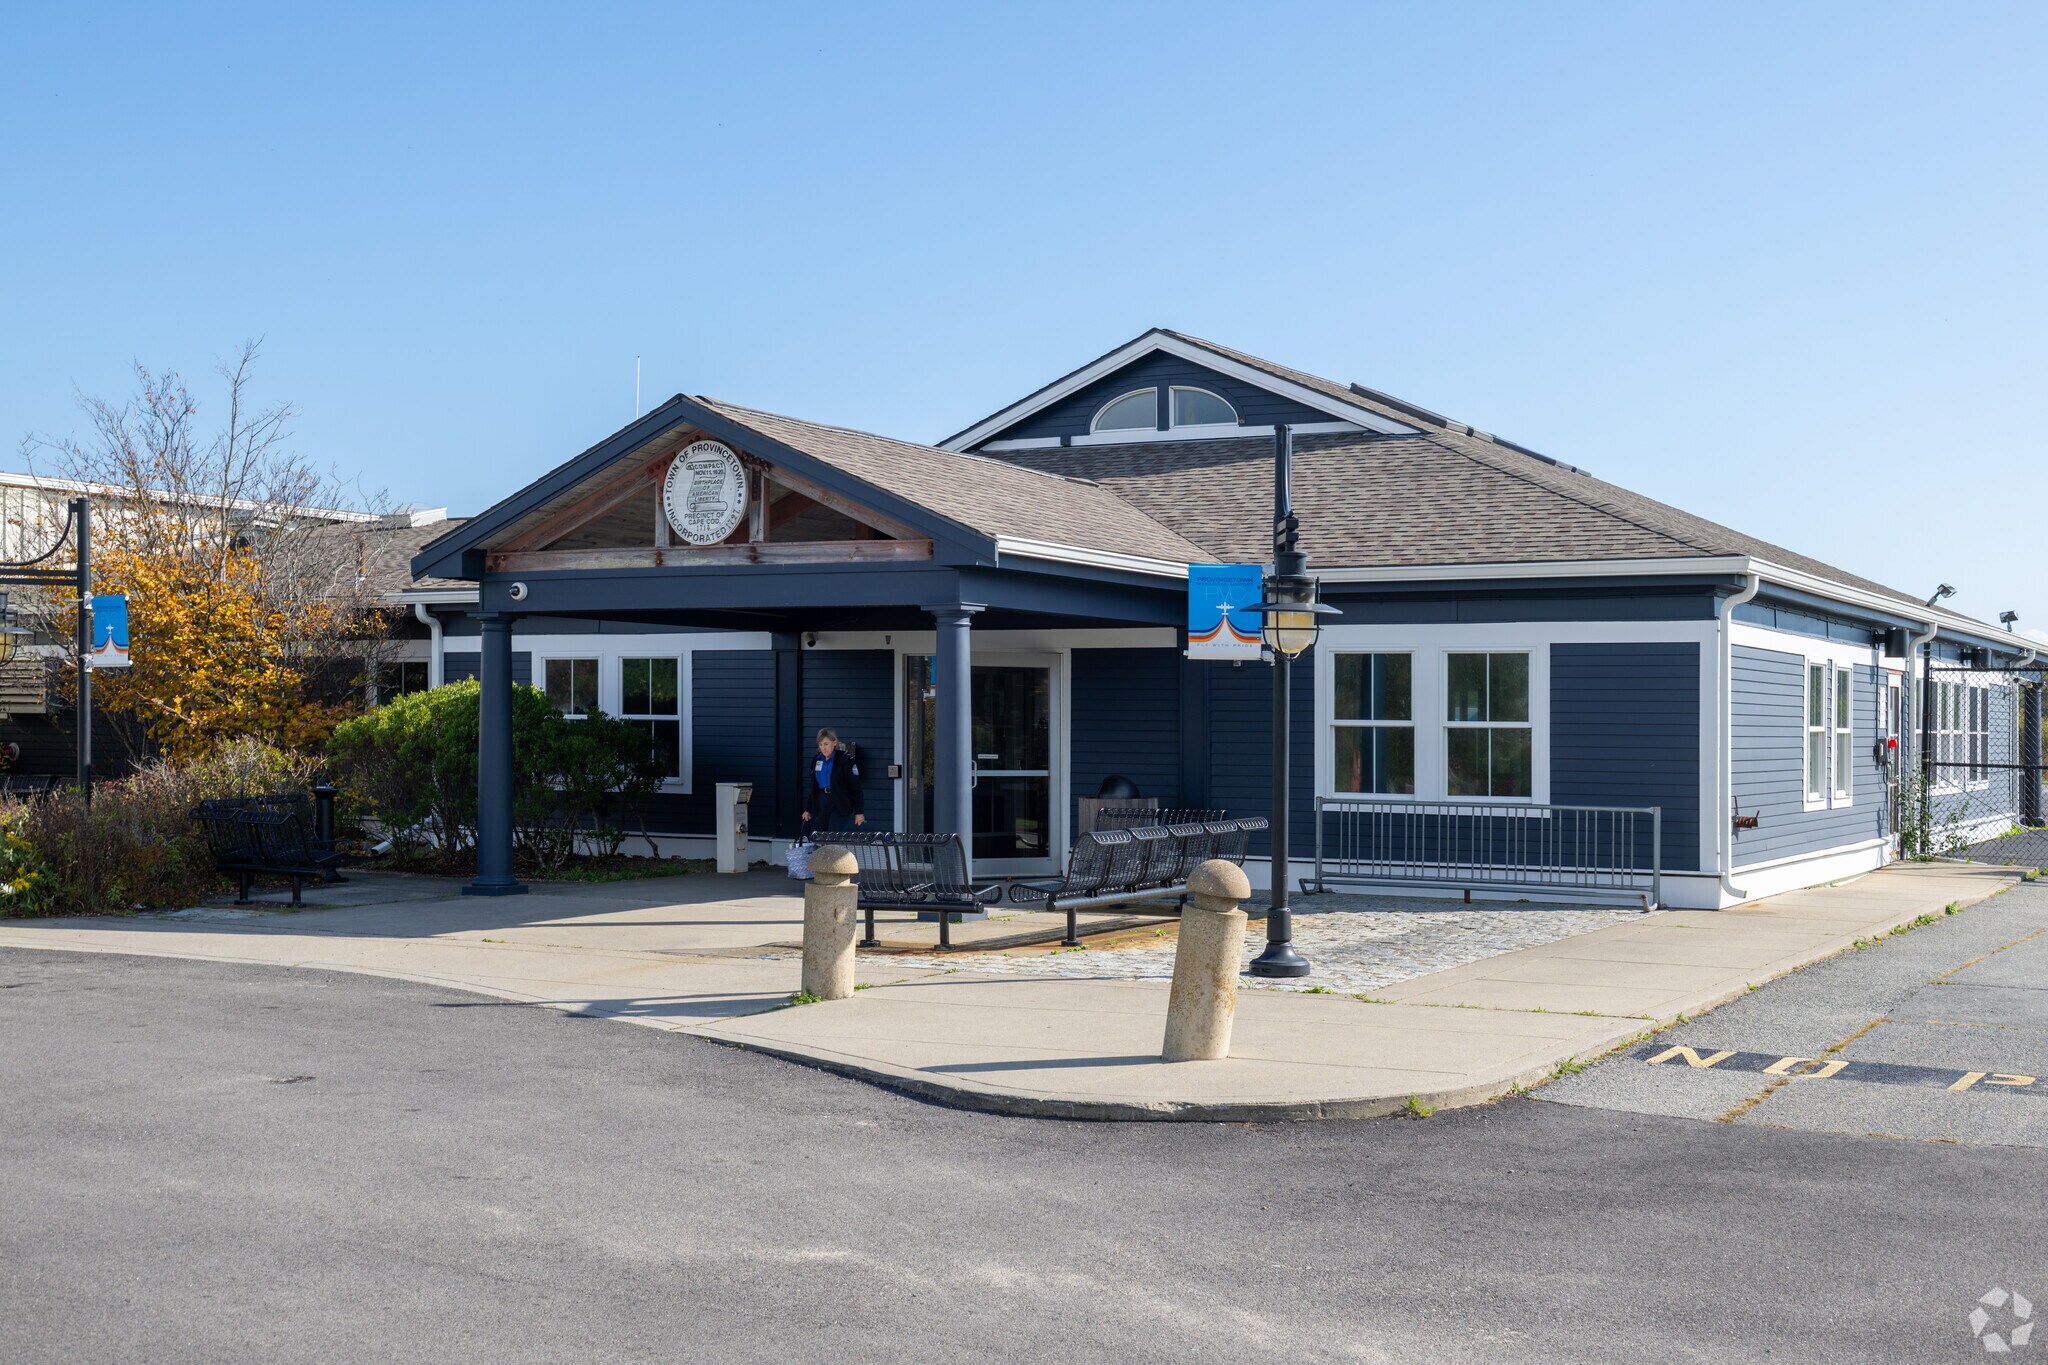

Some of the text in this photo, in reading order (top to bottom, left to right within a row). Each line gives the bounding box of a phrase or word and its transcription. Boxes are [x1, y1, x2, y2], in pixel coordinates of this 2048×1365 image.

[666, 464, 679, 494] TOWN
[678, 451, 689, 463] OF
[667, 508, 728, 542] INCORPORATED
[1205, 585, 1246, 602] PVC
[1646, 1046, 2039, 1092] NO P
